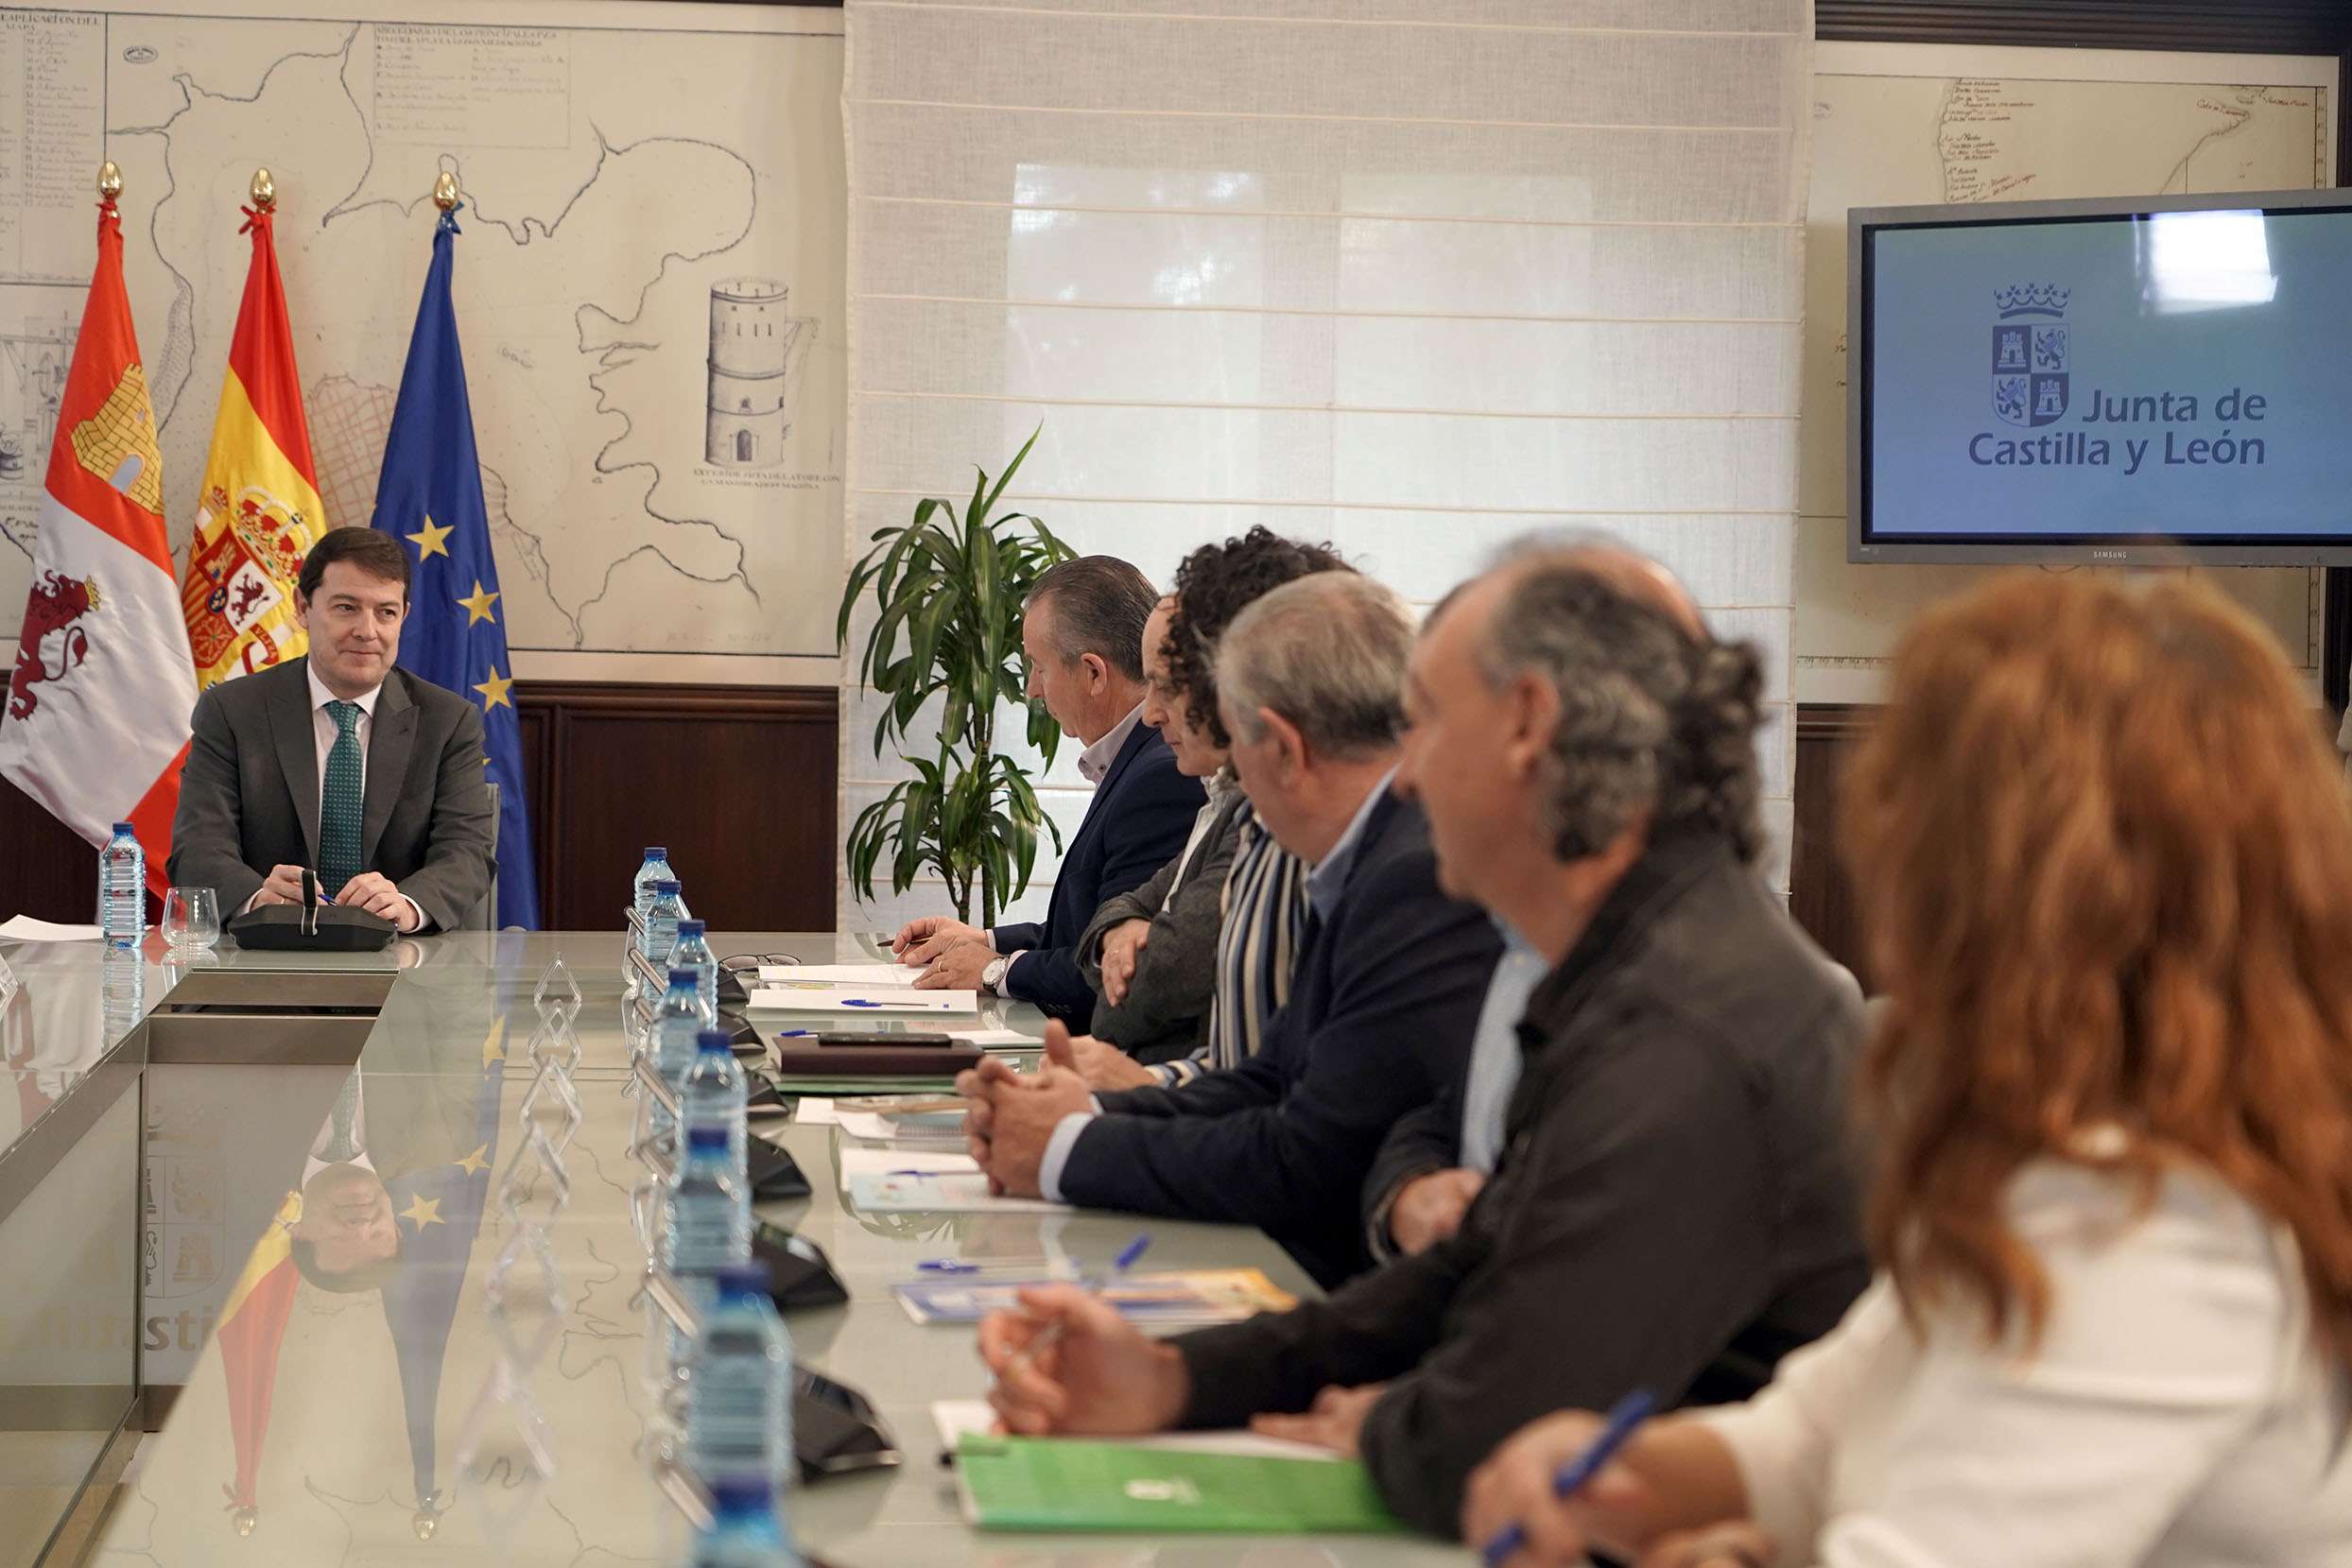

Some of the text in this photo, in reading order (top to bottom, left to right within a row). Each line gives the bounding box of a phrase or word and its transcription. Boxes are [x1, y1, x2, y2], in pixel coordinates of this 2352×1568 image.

[2082, 387, 2267, 422] Junta de
[1968, 429, 2266, 475] Castilla y León
[2093, 551, 2127, 560] SAMSUNG
[143, 1301, 213, 1352] sti
